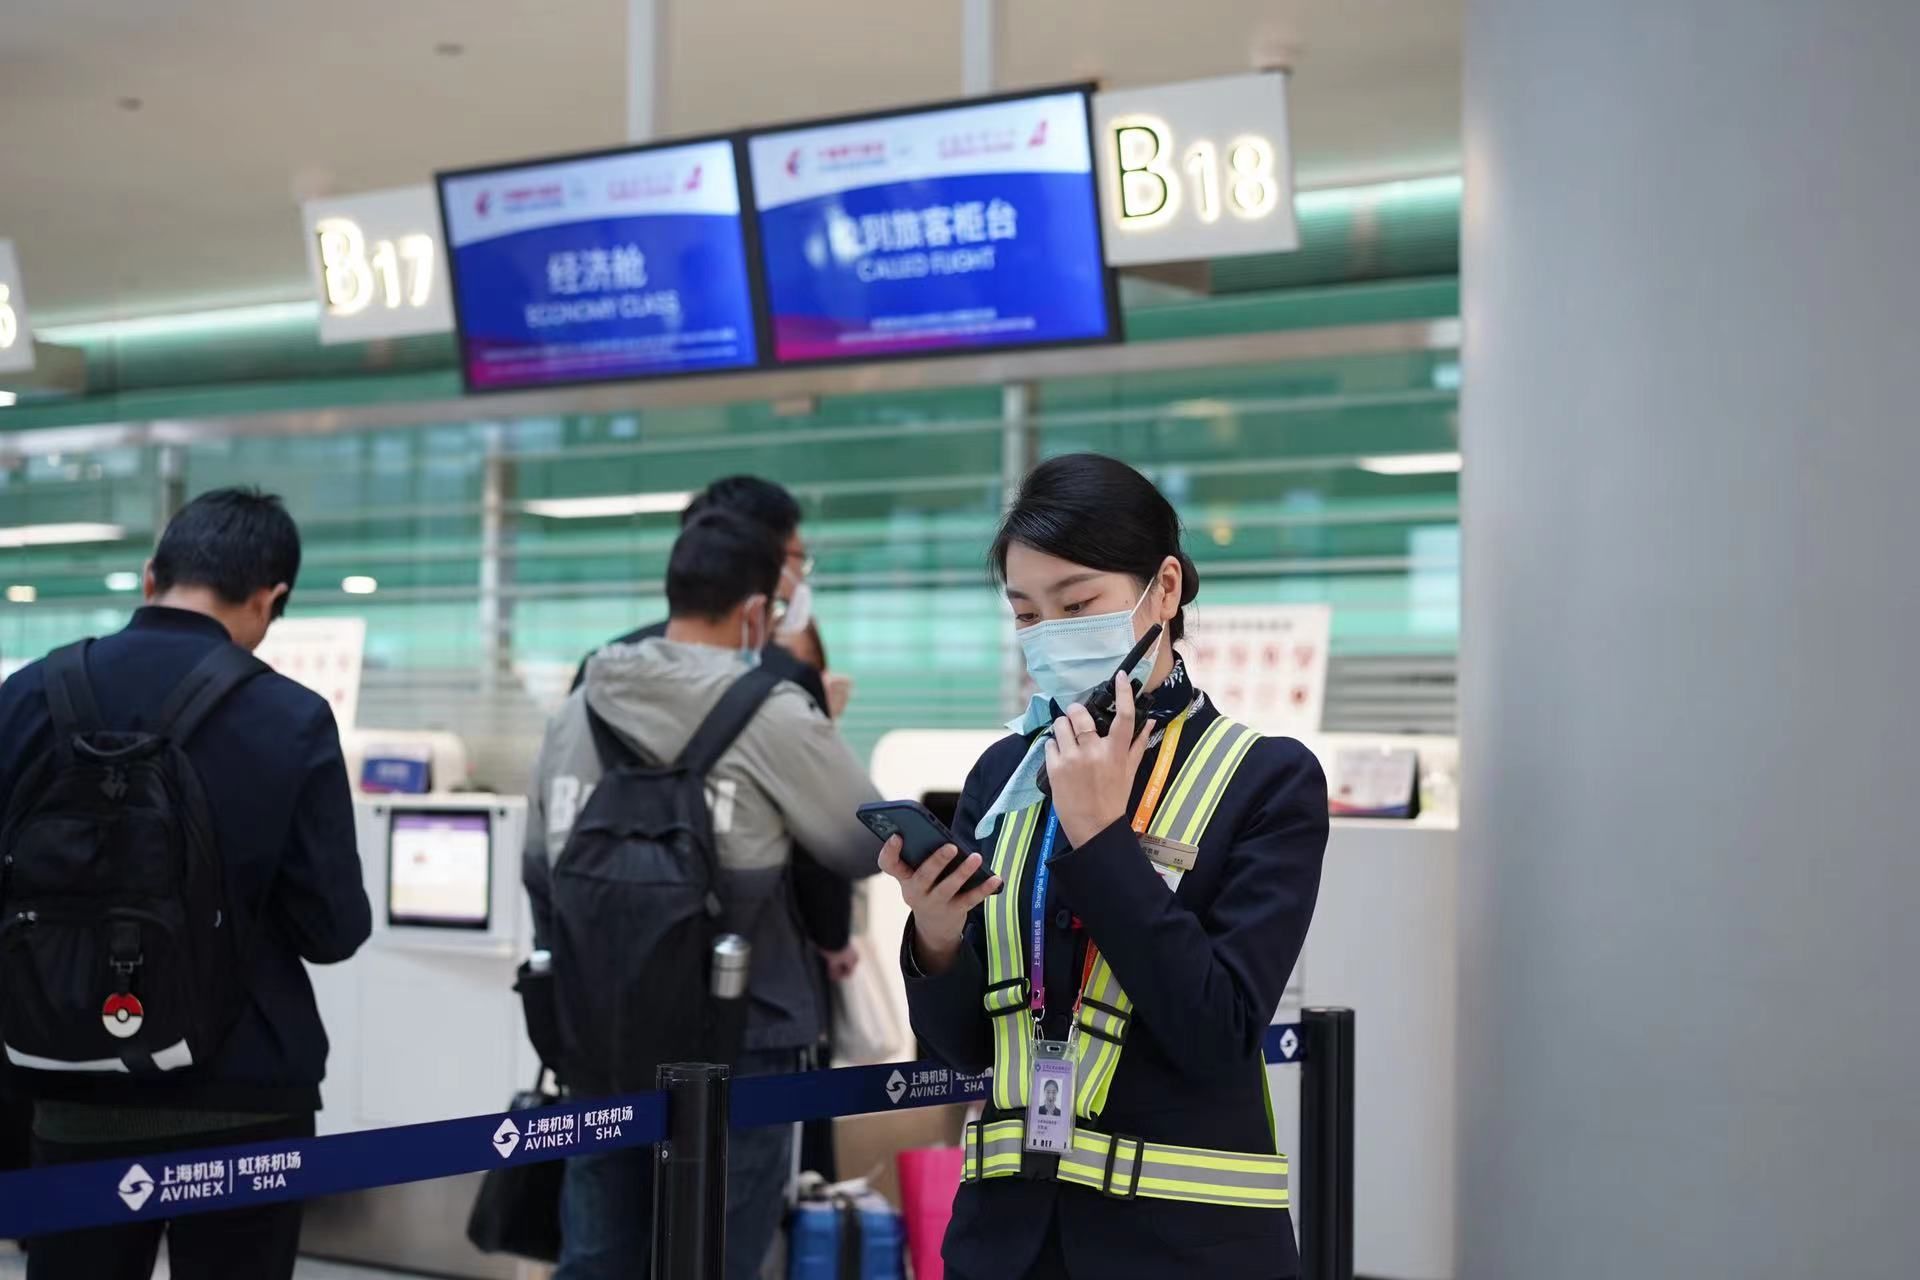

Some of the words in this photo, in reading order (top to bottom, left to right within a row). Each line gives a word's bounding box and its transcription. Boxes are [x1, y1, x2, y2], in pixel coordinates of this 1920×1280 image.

[1109, 117, 1278, 227] B18
[317, 218, 434, 315] B17
[547, 243, 648, 295] 经济舱
[857, 253, 930, 283] CALLED
[930, 245, 996, 275] FLIGHT
[525, 299, 618, 329] ECONOMY
[1034, 877, 1044, 909] Shanghai
[909, 1084, 947, 1099] AVINEX
[963, 1080, 985, 1093] SHA
[910, 1069, 948, 1086] 上海机场
[524, 1114, 574, 1136] 上海机场
[584, 1105, 633, 1127] 虹桥机场
[524, 1132, 574, 1151] AVINEX
[595, 1125, 622, 1141] SHA
[160, 1161, 225, 1186] 上海机场
[238, 1151, 301, 1176] 虹桥机场
[160, 1181, 225, 1203] AVINEX
[252, 1173, 287, 1192] SHA
